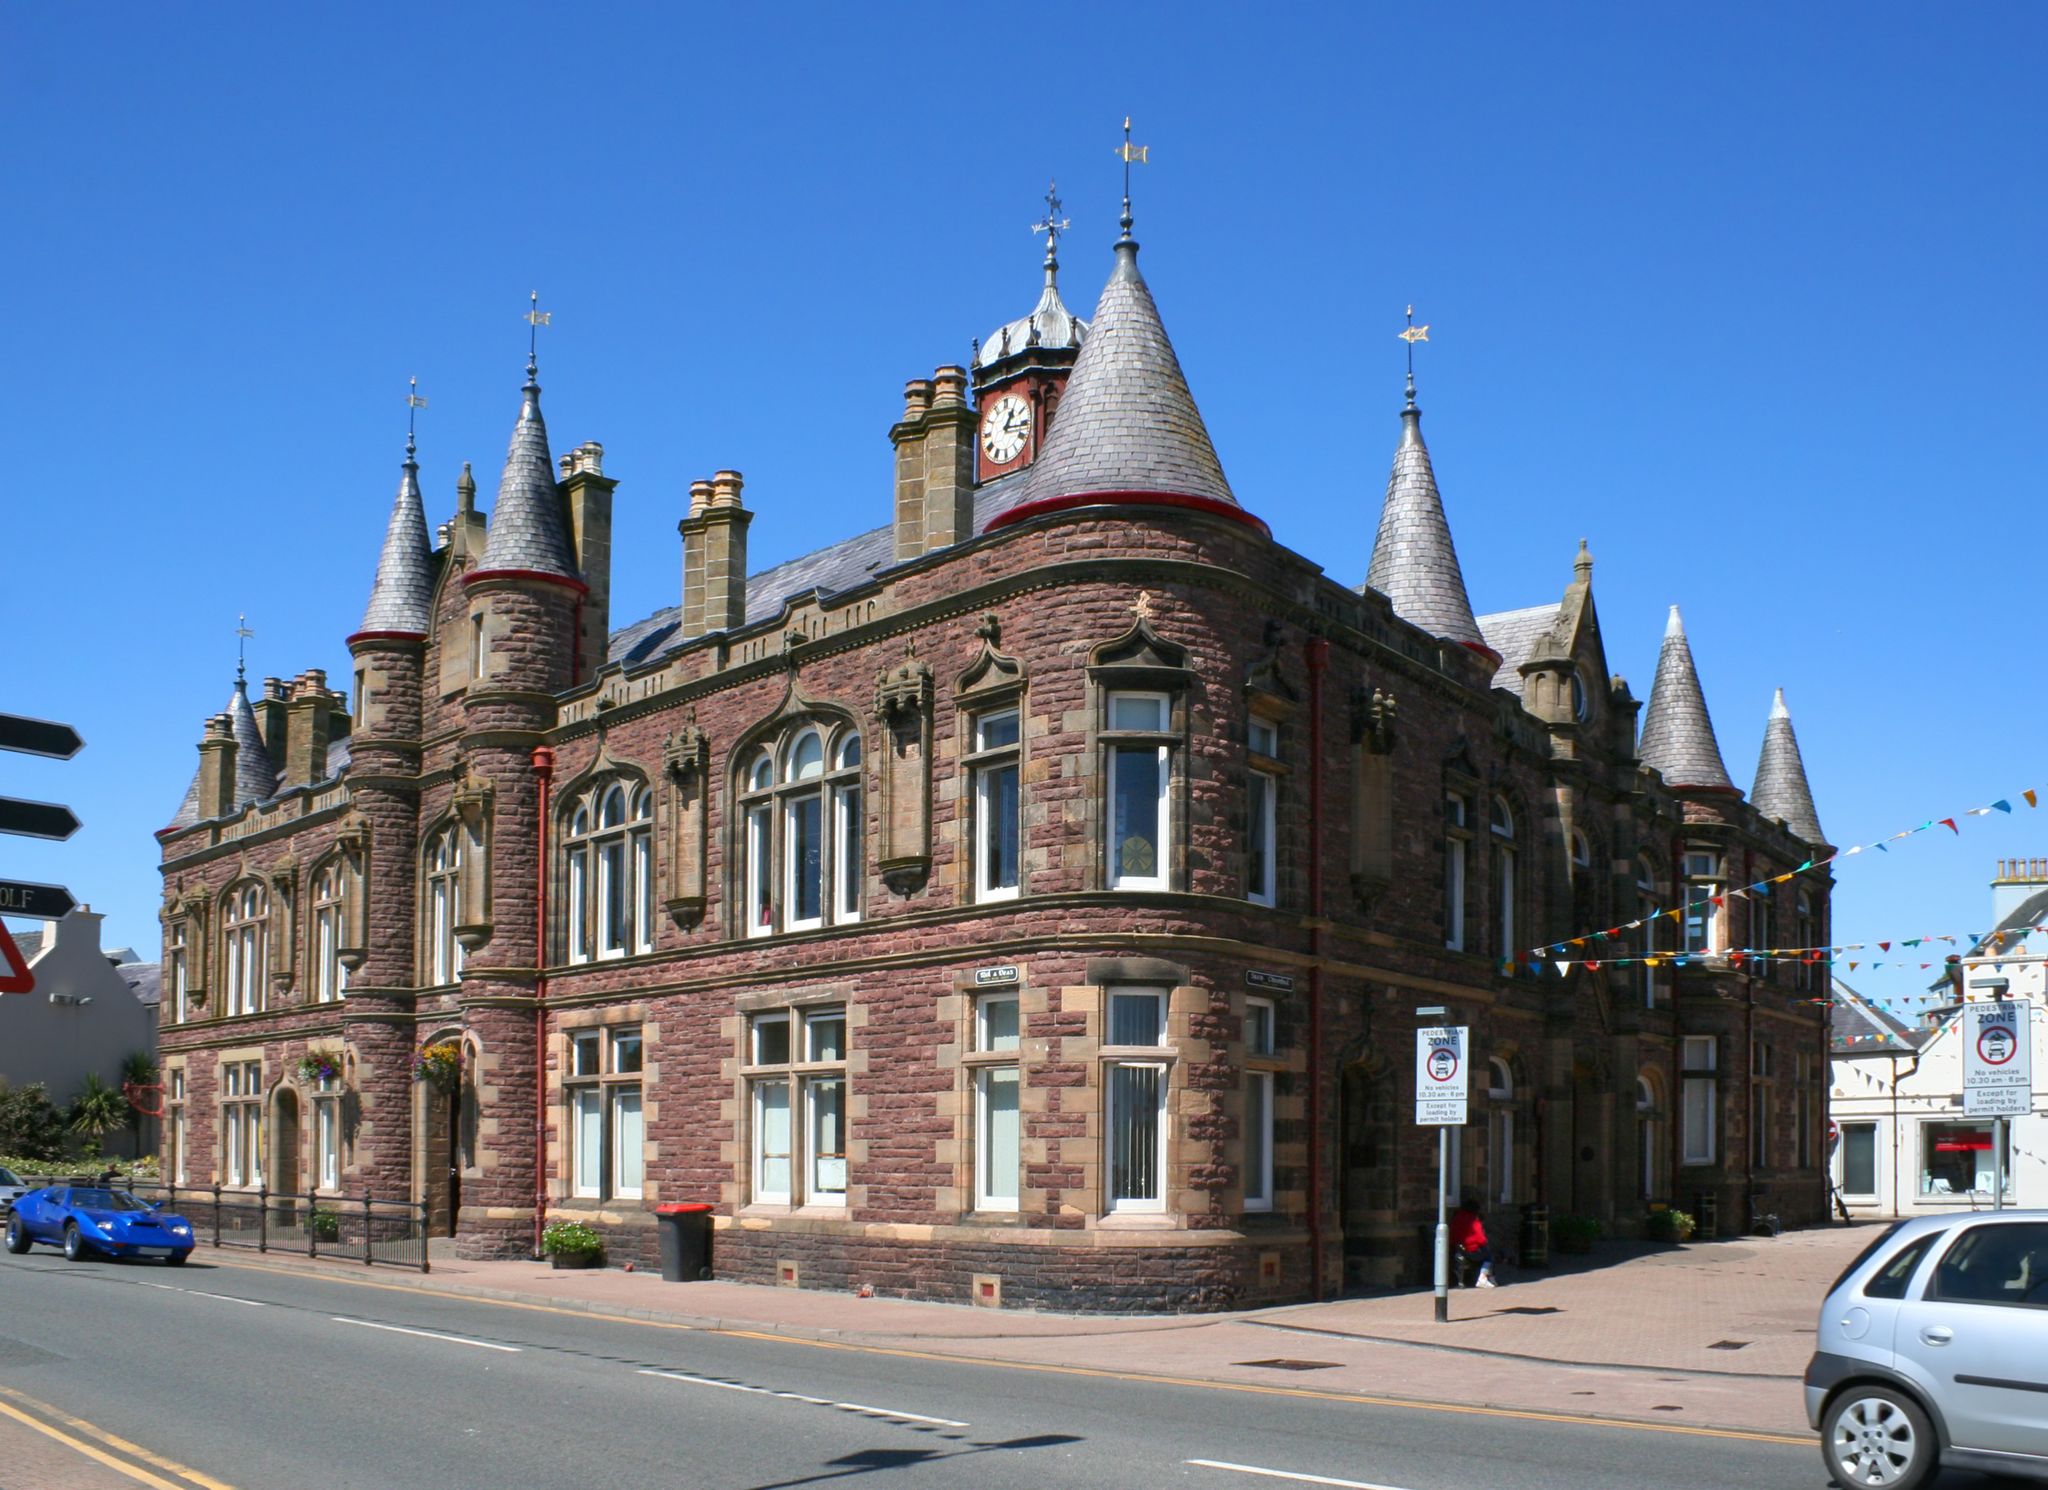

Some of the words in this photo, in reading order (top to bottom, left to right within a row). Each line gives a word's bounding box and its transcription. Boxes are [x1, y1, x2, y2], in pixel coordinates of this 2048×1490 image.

[1970, 1003, 2023, 1012] PEDESTRIAN
[1978, 1012, 2015, 1023] ZONE
[1428, 1036, 1457, 1046] ZONE
[1969, 1106, 1994, 1114] permit
